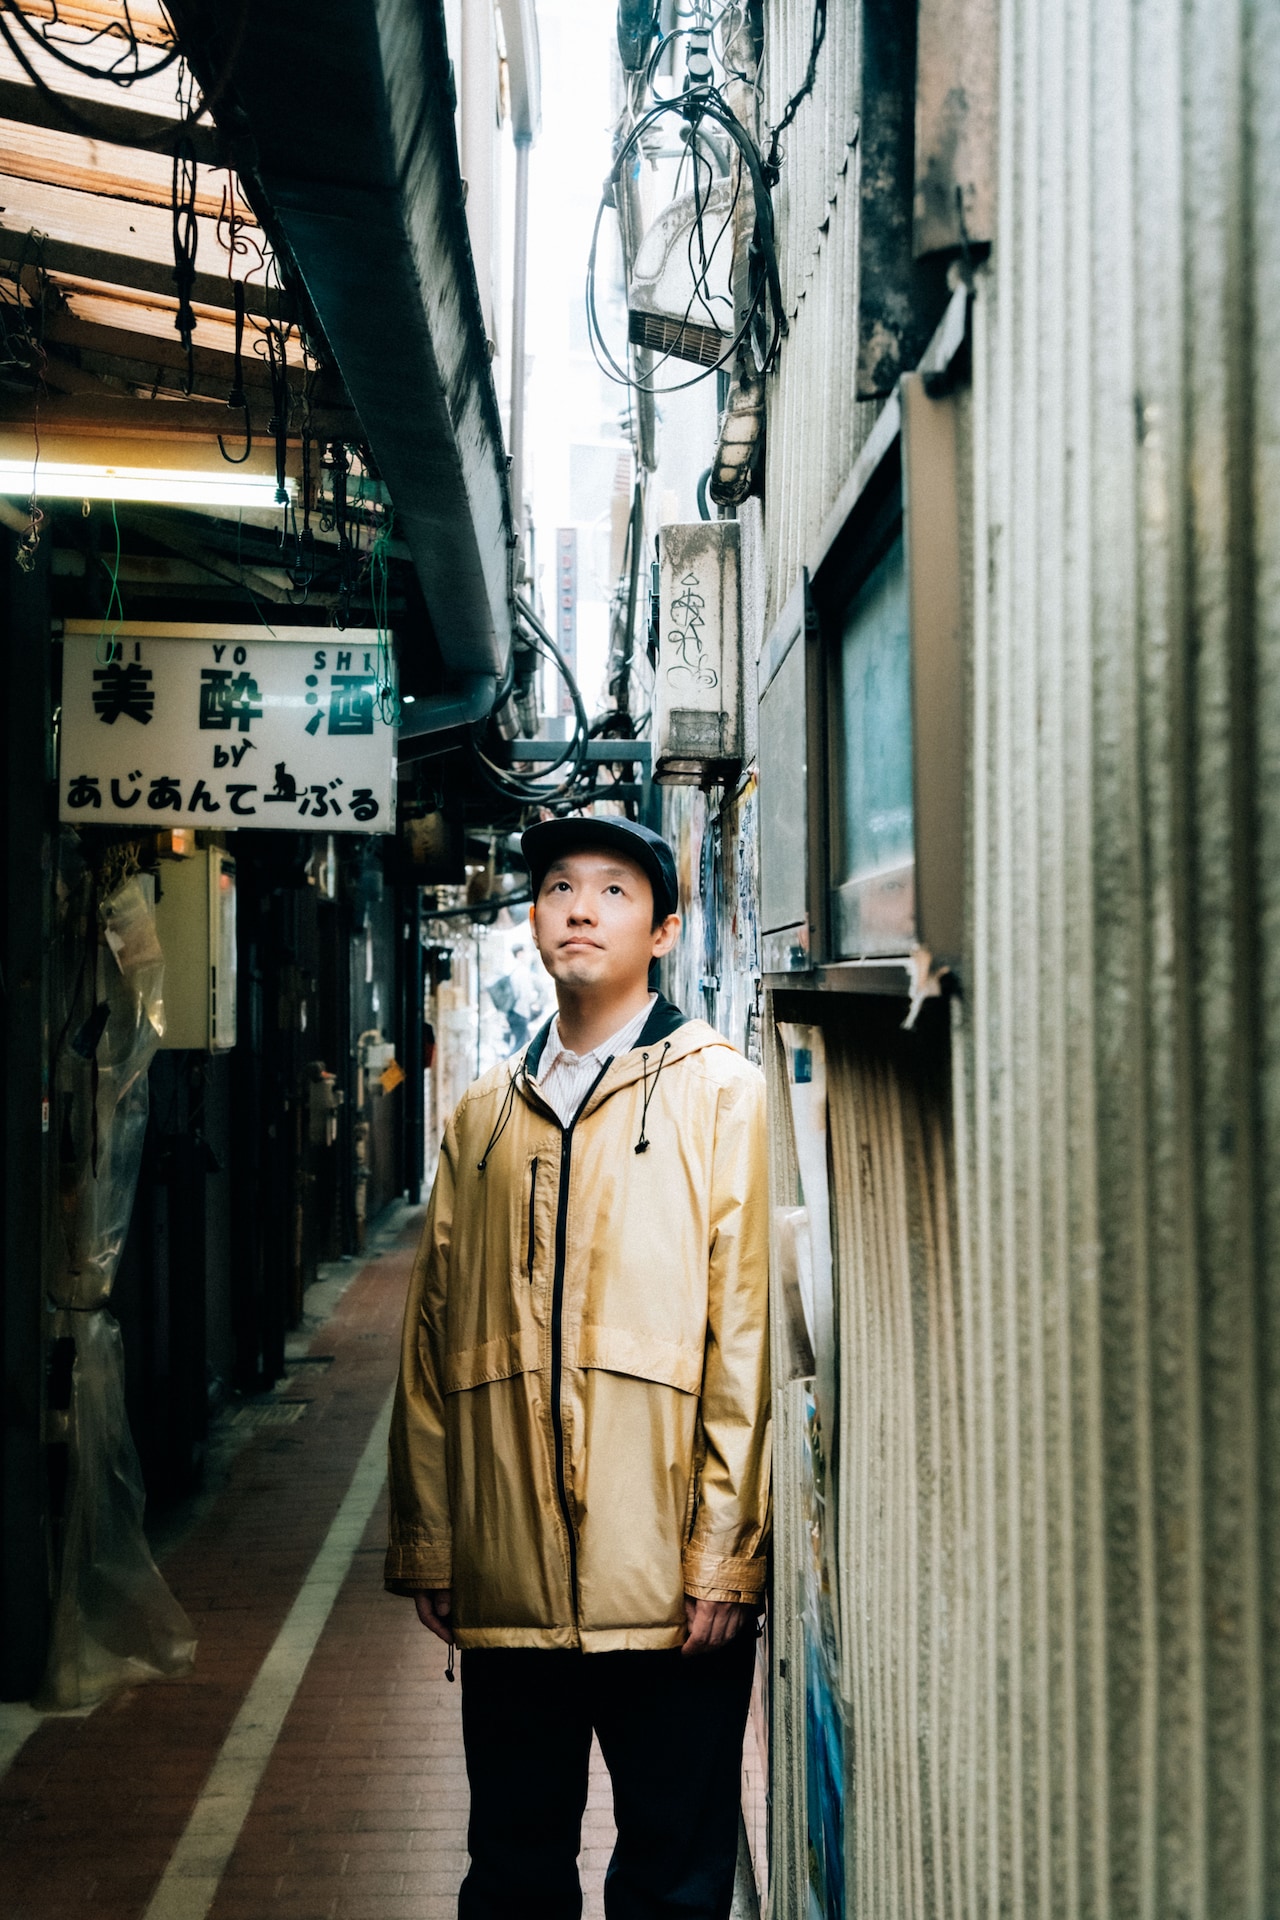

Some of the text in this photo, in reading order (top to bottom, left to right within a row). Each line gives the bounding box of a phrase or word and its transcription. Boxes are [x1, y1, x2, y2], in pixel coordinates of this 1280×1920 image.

[106, 641, 371, 672] MI YO SHI
[213, 740, 250, 768] by
